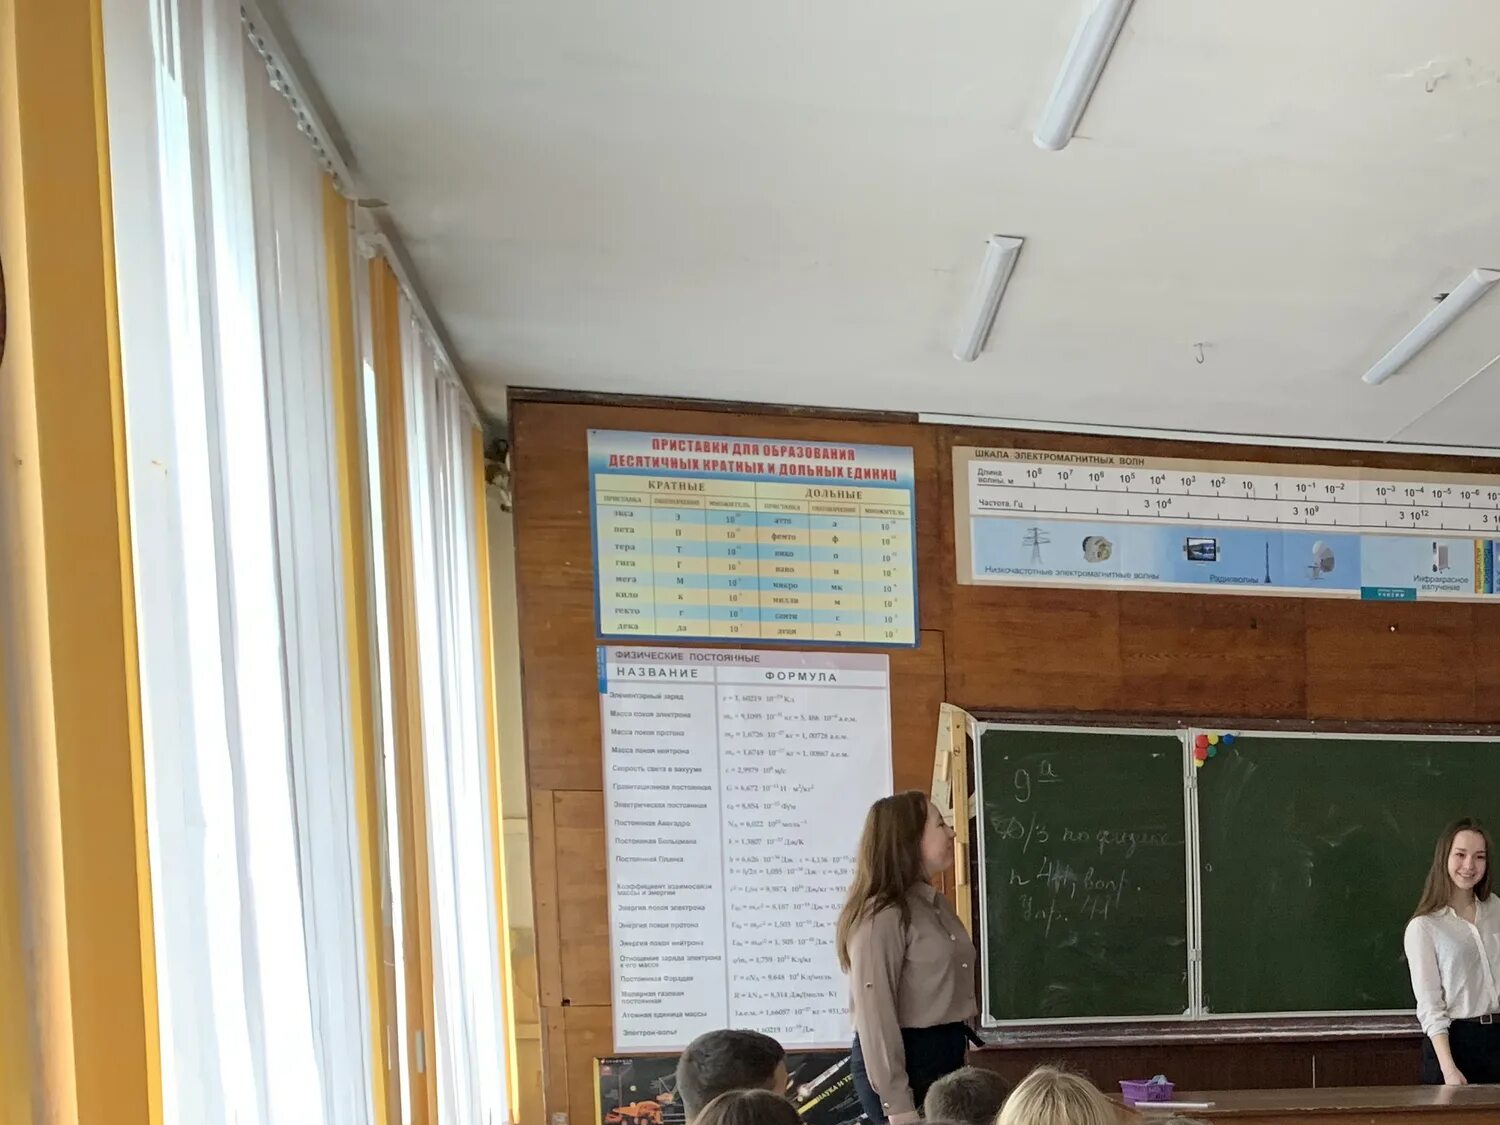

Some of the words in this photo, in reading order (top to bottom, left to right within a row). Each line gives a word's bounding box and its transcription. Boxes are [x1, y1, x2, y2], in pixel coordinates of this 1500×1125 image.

[652, 438, 729, 454] ПРИСТАВКИ
[732, 442, 759, 456] ДЛЯ
[763, 444, 856, 461] ОБРАЗОВАНИЯ
[974, 449, 1010, 459] ШКАЛА
[1014, 451, 1116, 465] ЭЛЕКТРОМАГНИТНЫХ
[1119, 457, 1145, 467] ВОЛН
[608, 454, 700, 470] ДЕСЯТИЧНЫХ
[703, 459, 764, 474] КРАТНЫХ
[767, 464, 775, 475] И
[779, 464, 844, 478] ДОЛЬНЫХ
[848, 467, 897, 482] ЕДИНИЦ
[648, 480, 706, 492] КРАТНЫЕ
[1242, 481, 1253, 490] 10
[804, 489, 863, 500] ДОЛЬНЫЕ
[1413, 575, 1469, 585] Инфракрасное
[615, 651, 684, 661] ФИЗИЧЕСКИЕ
[690, 653, 760, 663] ПОСТОЯННЫЕ
[616, 667, 698, 678] НАЗВАНИЕ
[765, 672, 837, 682] ФОРМУЛА
